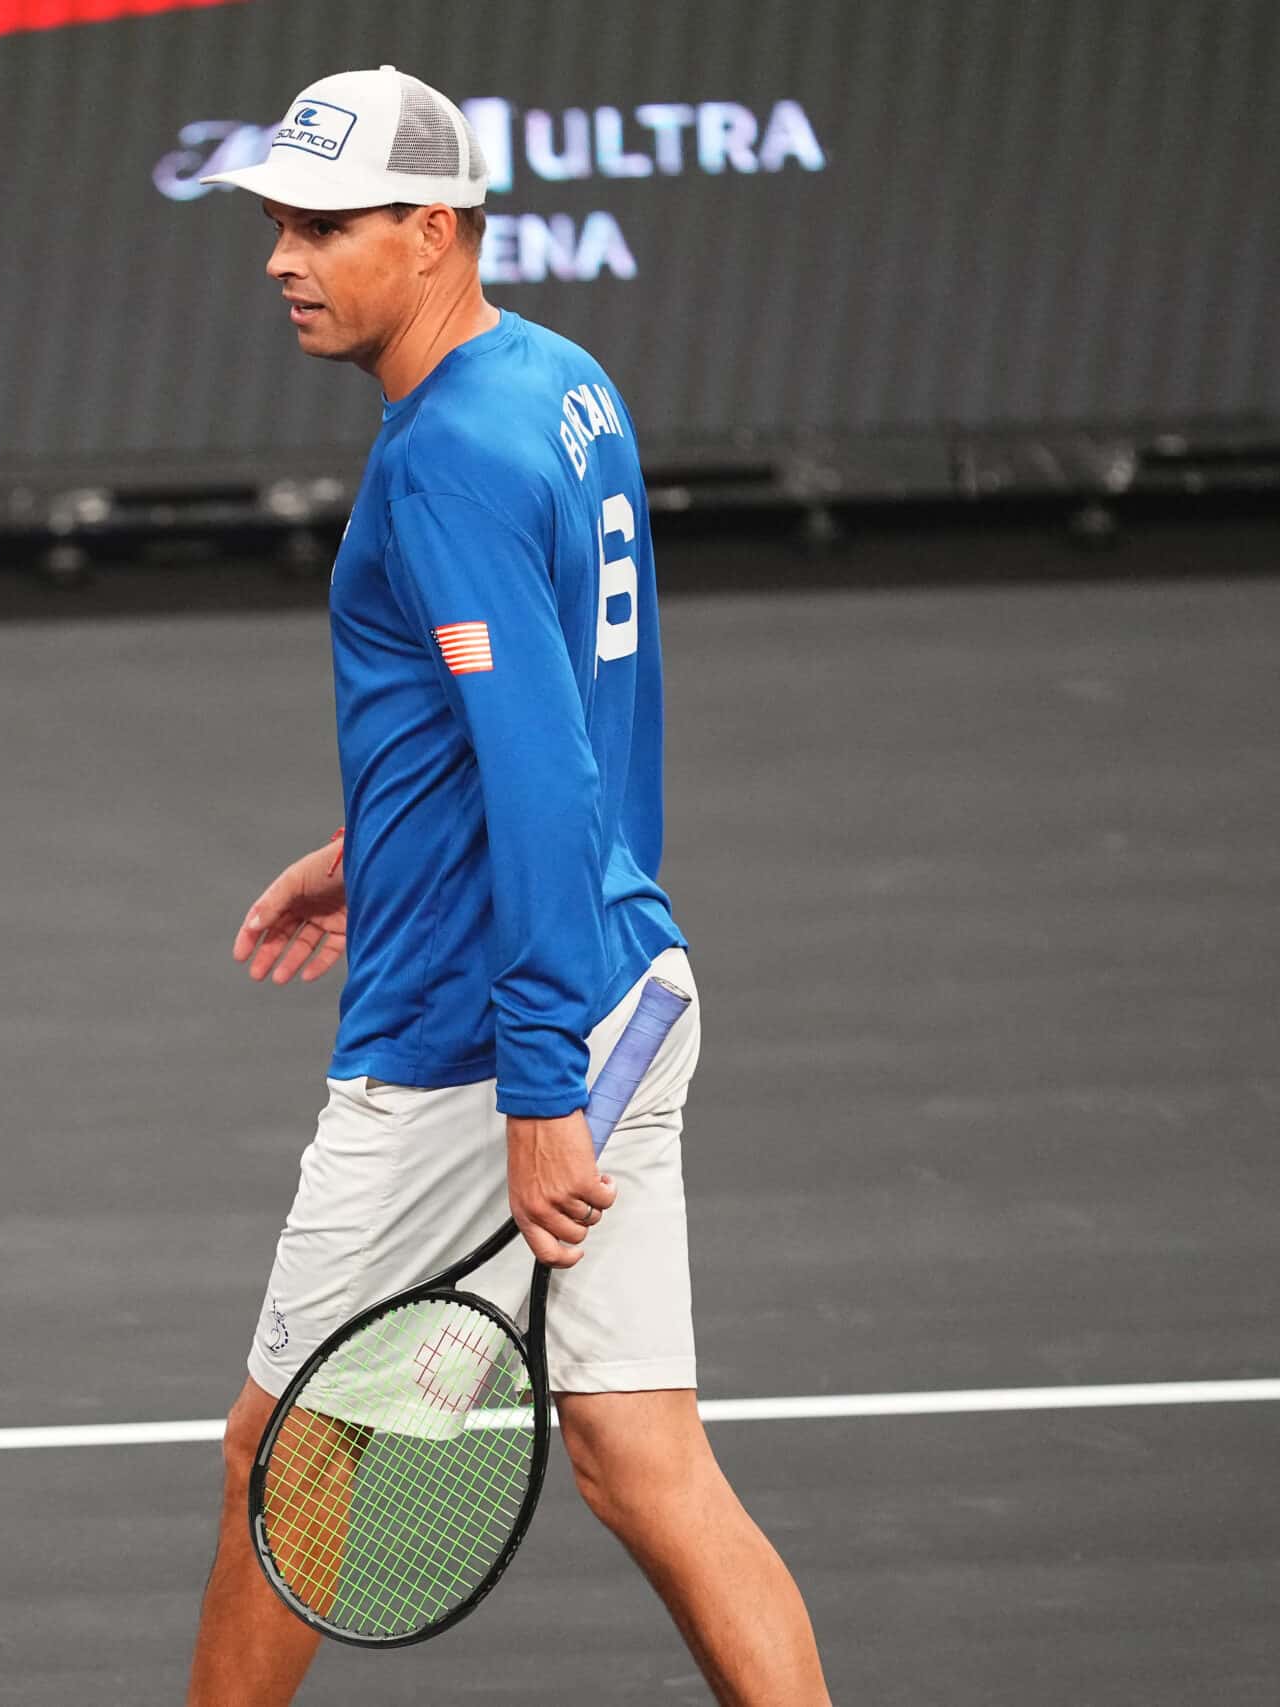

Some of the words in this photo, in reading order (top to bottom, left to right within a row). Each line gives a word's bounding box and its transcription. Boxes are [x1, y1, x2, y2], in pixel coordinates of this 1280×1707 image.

[524, 99, 827, 181] ULTRA
[478, 210, 638, 284] ENA
[560, 383, 624, 481] BRYAN
[594, 493, 639, 681] 6
